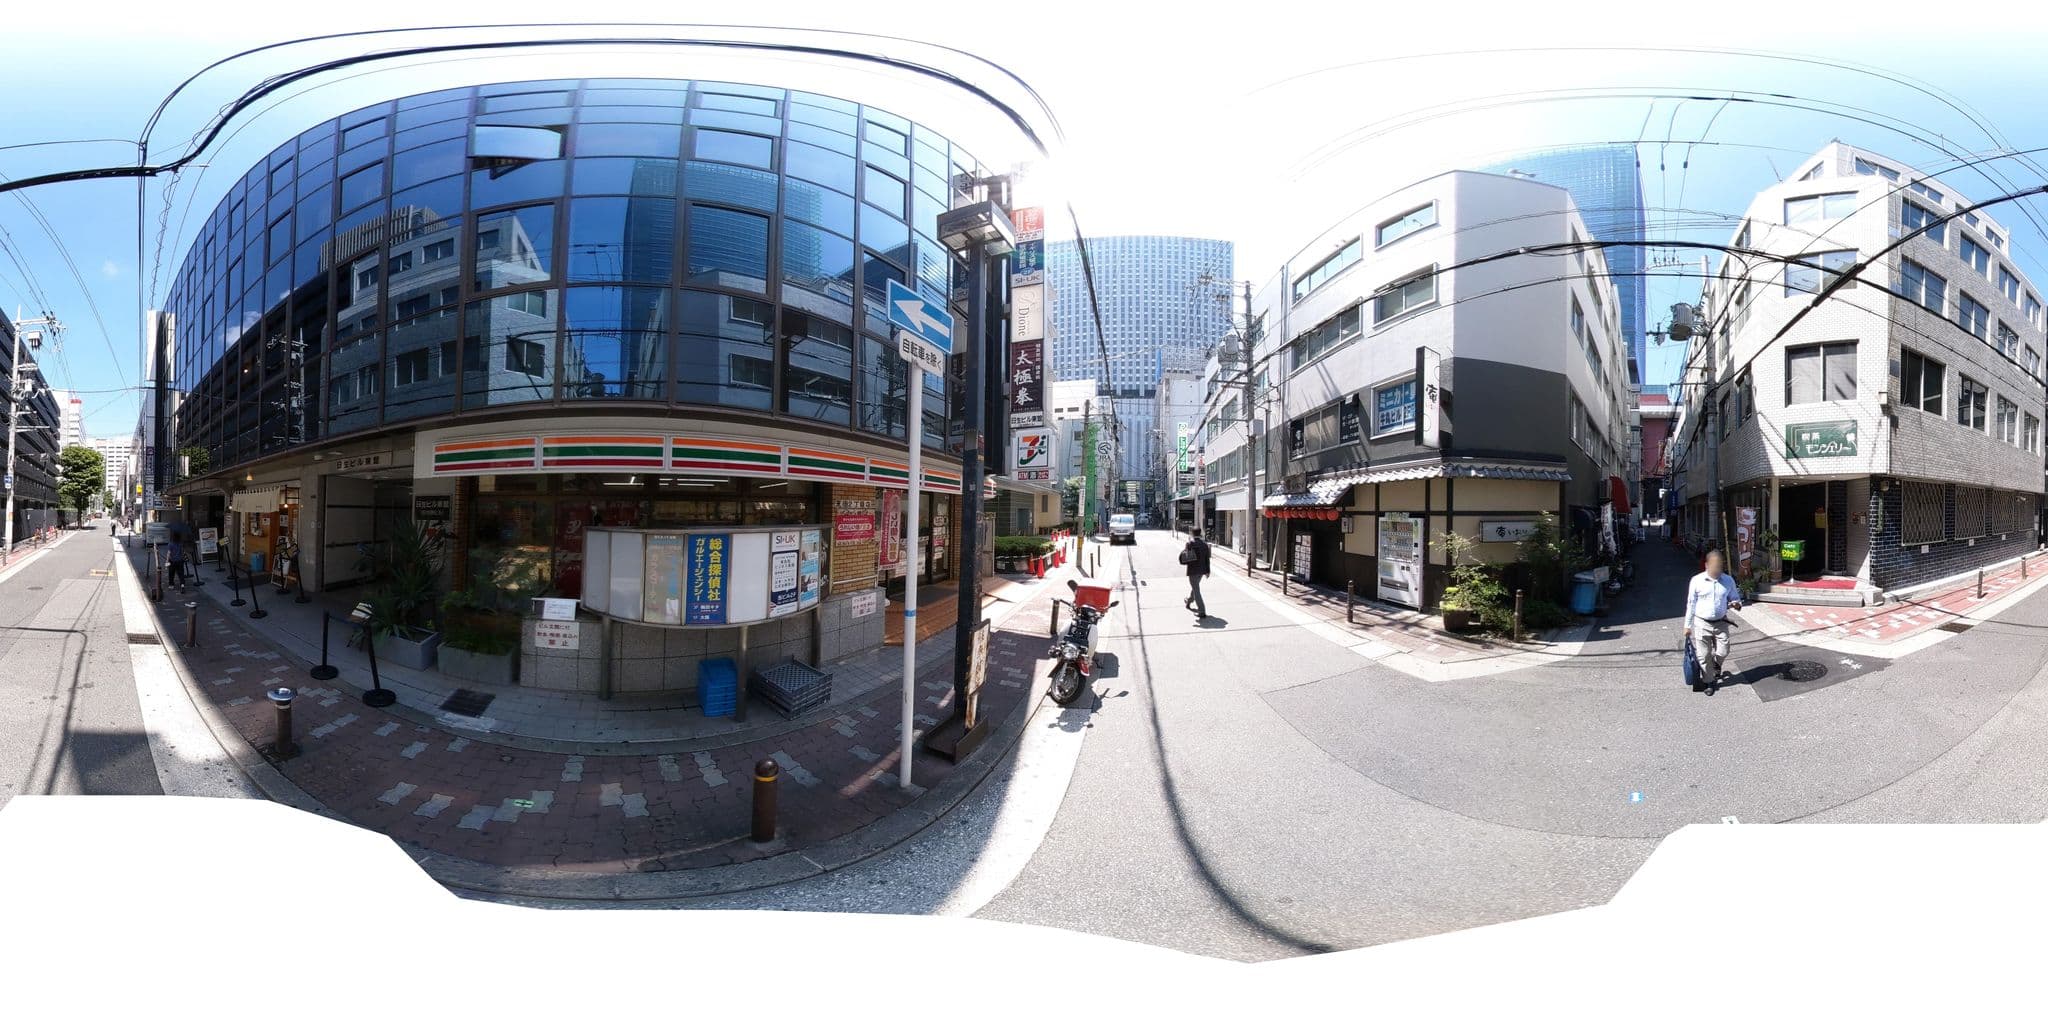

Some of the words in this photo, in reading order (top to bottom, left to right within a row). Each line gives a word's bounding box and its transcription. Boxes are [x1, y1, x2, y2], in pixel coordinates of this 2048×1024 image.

[1018, 307, 1029, 336] Dione
[903, 338, 942, 371] 自転車を除く
[1013, 350, 1034, 406] 太極拳
[694, 538, 705, 601] ガルエージェンシー
[707, 538, 722, 601] 総合探偵社
